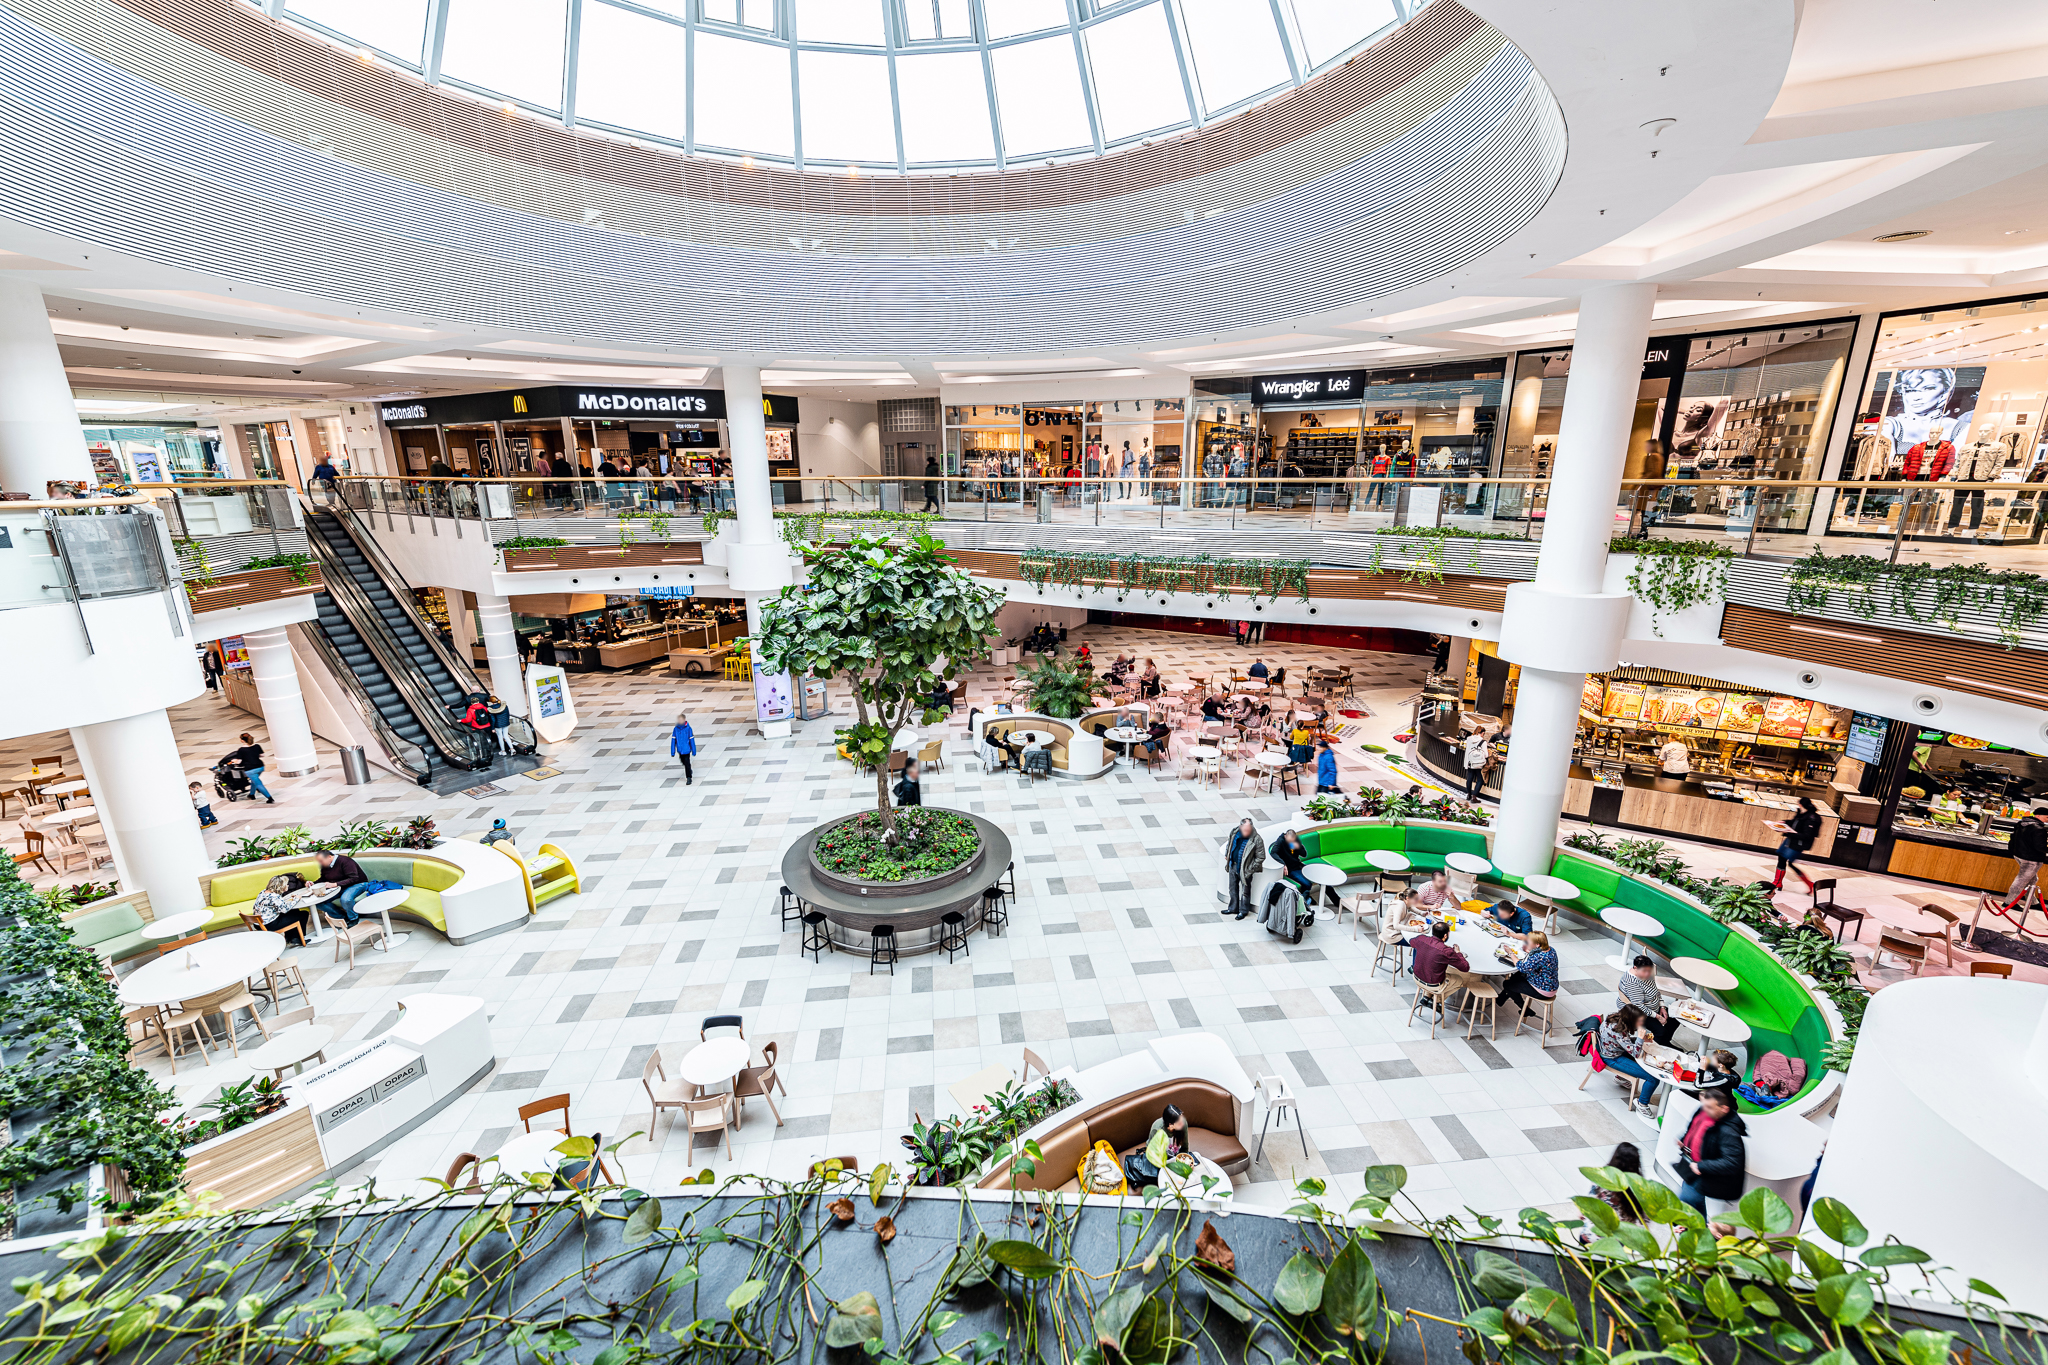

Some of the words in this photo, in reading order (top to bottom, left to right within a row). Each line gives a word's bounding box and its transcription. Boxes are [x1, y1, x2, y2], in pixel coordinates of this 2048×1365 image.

[1261, 380, 1320, 399] Wrangler
[1328, 378, 1351, 391] Lee
[579, 394, 707, 411] McDonald's
[382, 404, 426, 420] McDonald's
[1415, 458, 1440, 466] TEXA
[1447, 458, 1469, 466] SLIM
[385, 1067, 414, 1087] ODPAD
[331, 1096, 364, 1118] ODPAD
